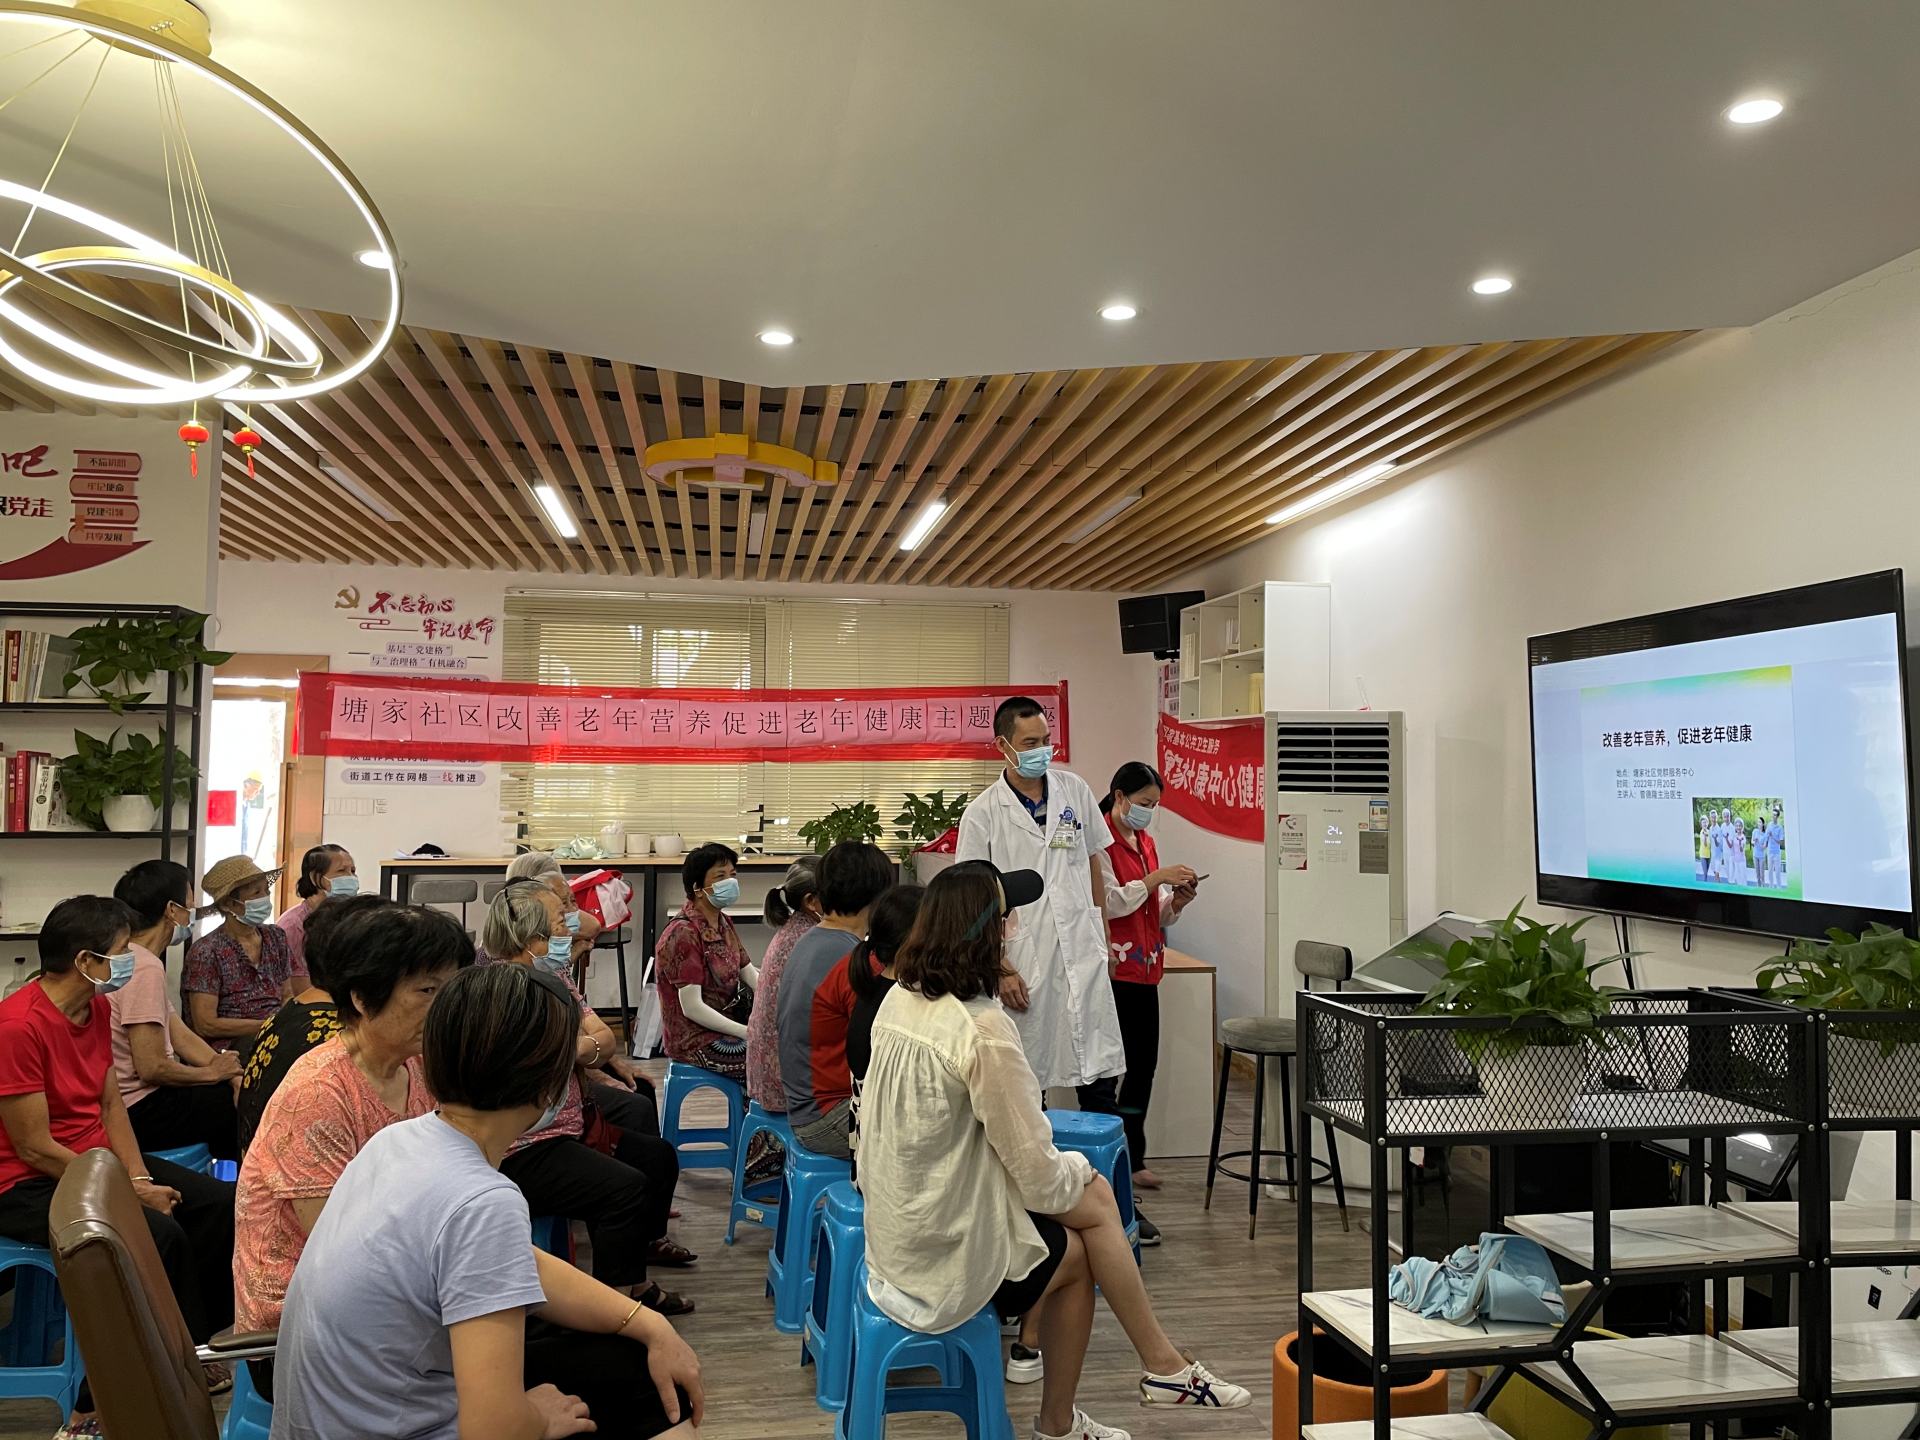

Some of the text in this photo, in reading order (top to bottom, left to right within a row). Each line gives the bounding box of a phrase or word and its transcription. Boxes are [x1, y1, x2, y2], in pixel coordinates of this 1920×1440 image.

[87, 482, 125, 492] 牢记使命
[86, 507, 124, 517] 党建引领
[86, 532, 123, 542] 共享发展
[368, 591, 454, 615] 不忘初心
[422, 618, 496, 645] 牢记使命
[339, 696, 1056, 736] 塘家社区改善老年营养促进老年健康主题座
[349, 771, 477, 783] 街道工作在网格一线推进
